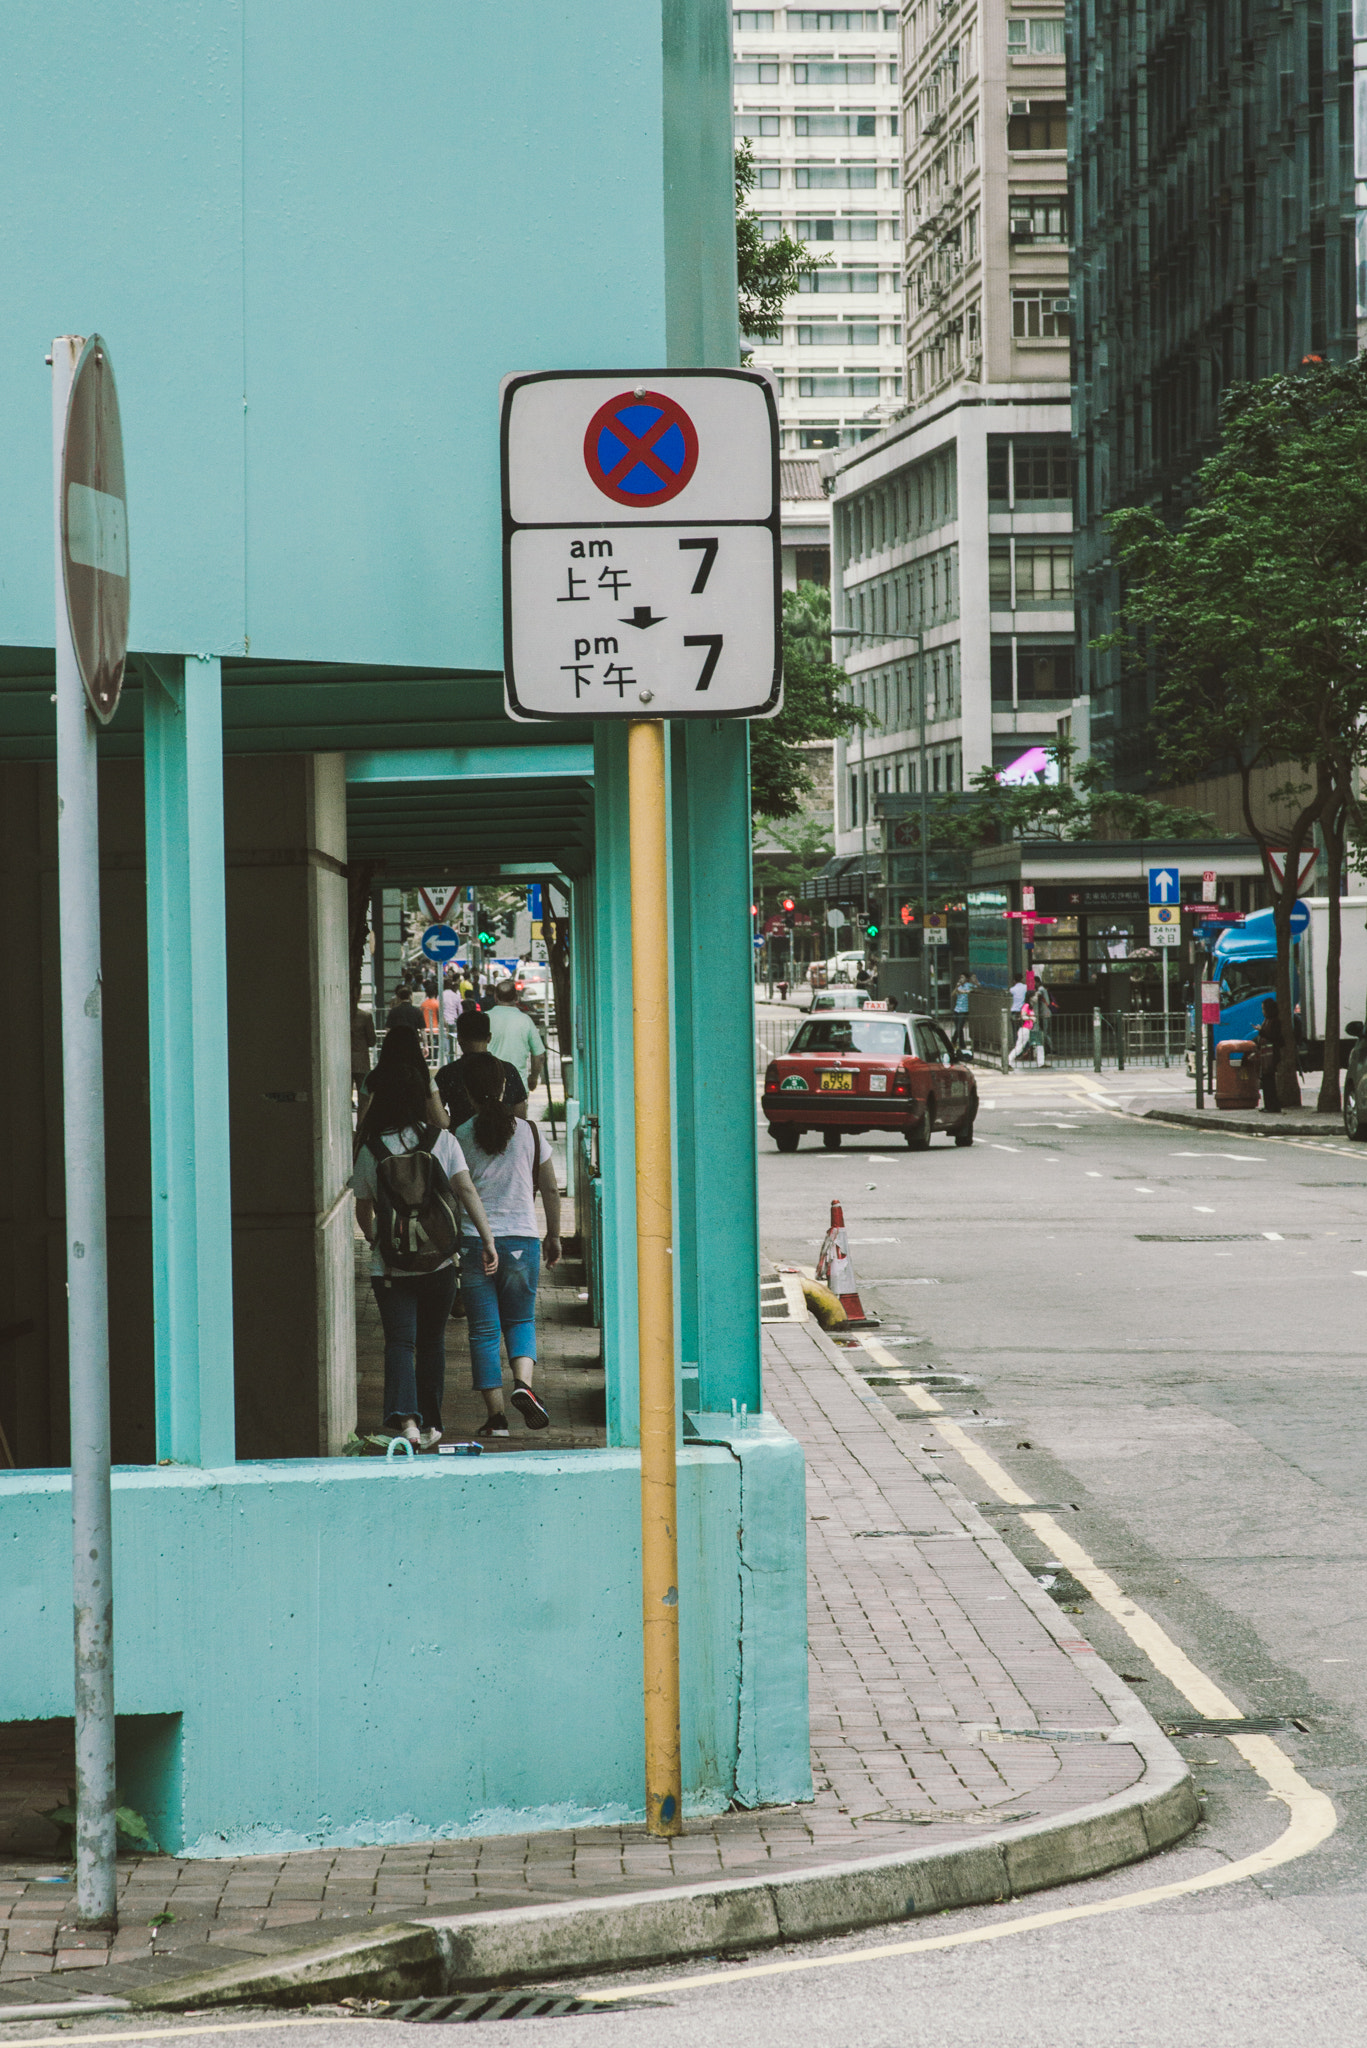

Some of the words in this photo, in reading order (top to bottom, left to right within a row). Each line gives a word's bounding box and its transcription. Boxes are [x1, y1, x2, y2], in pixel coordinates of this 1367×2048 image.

[557, 565, 631, 601] 上午
[570, 539, 613, 558] am
[678, 537, 719, 594] 7
[560, 662, 637, 698] 下午
[575, 635, 619, 660] pm
[683, 633, 724, 691] 7
[1156, 934, 1175, 944] 全日
[823, 1081, 850, 1089] 8736
